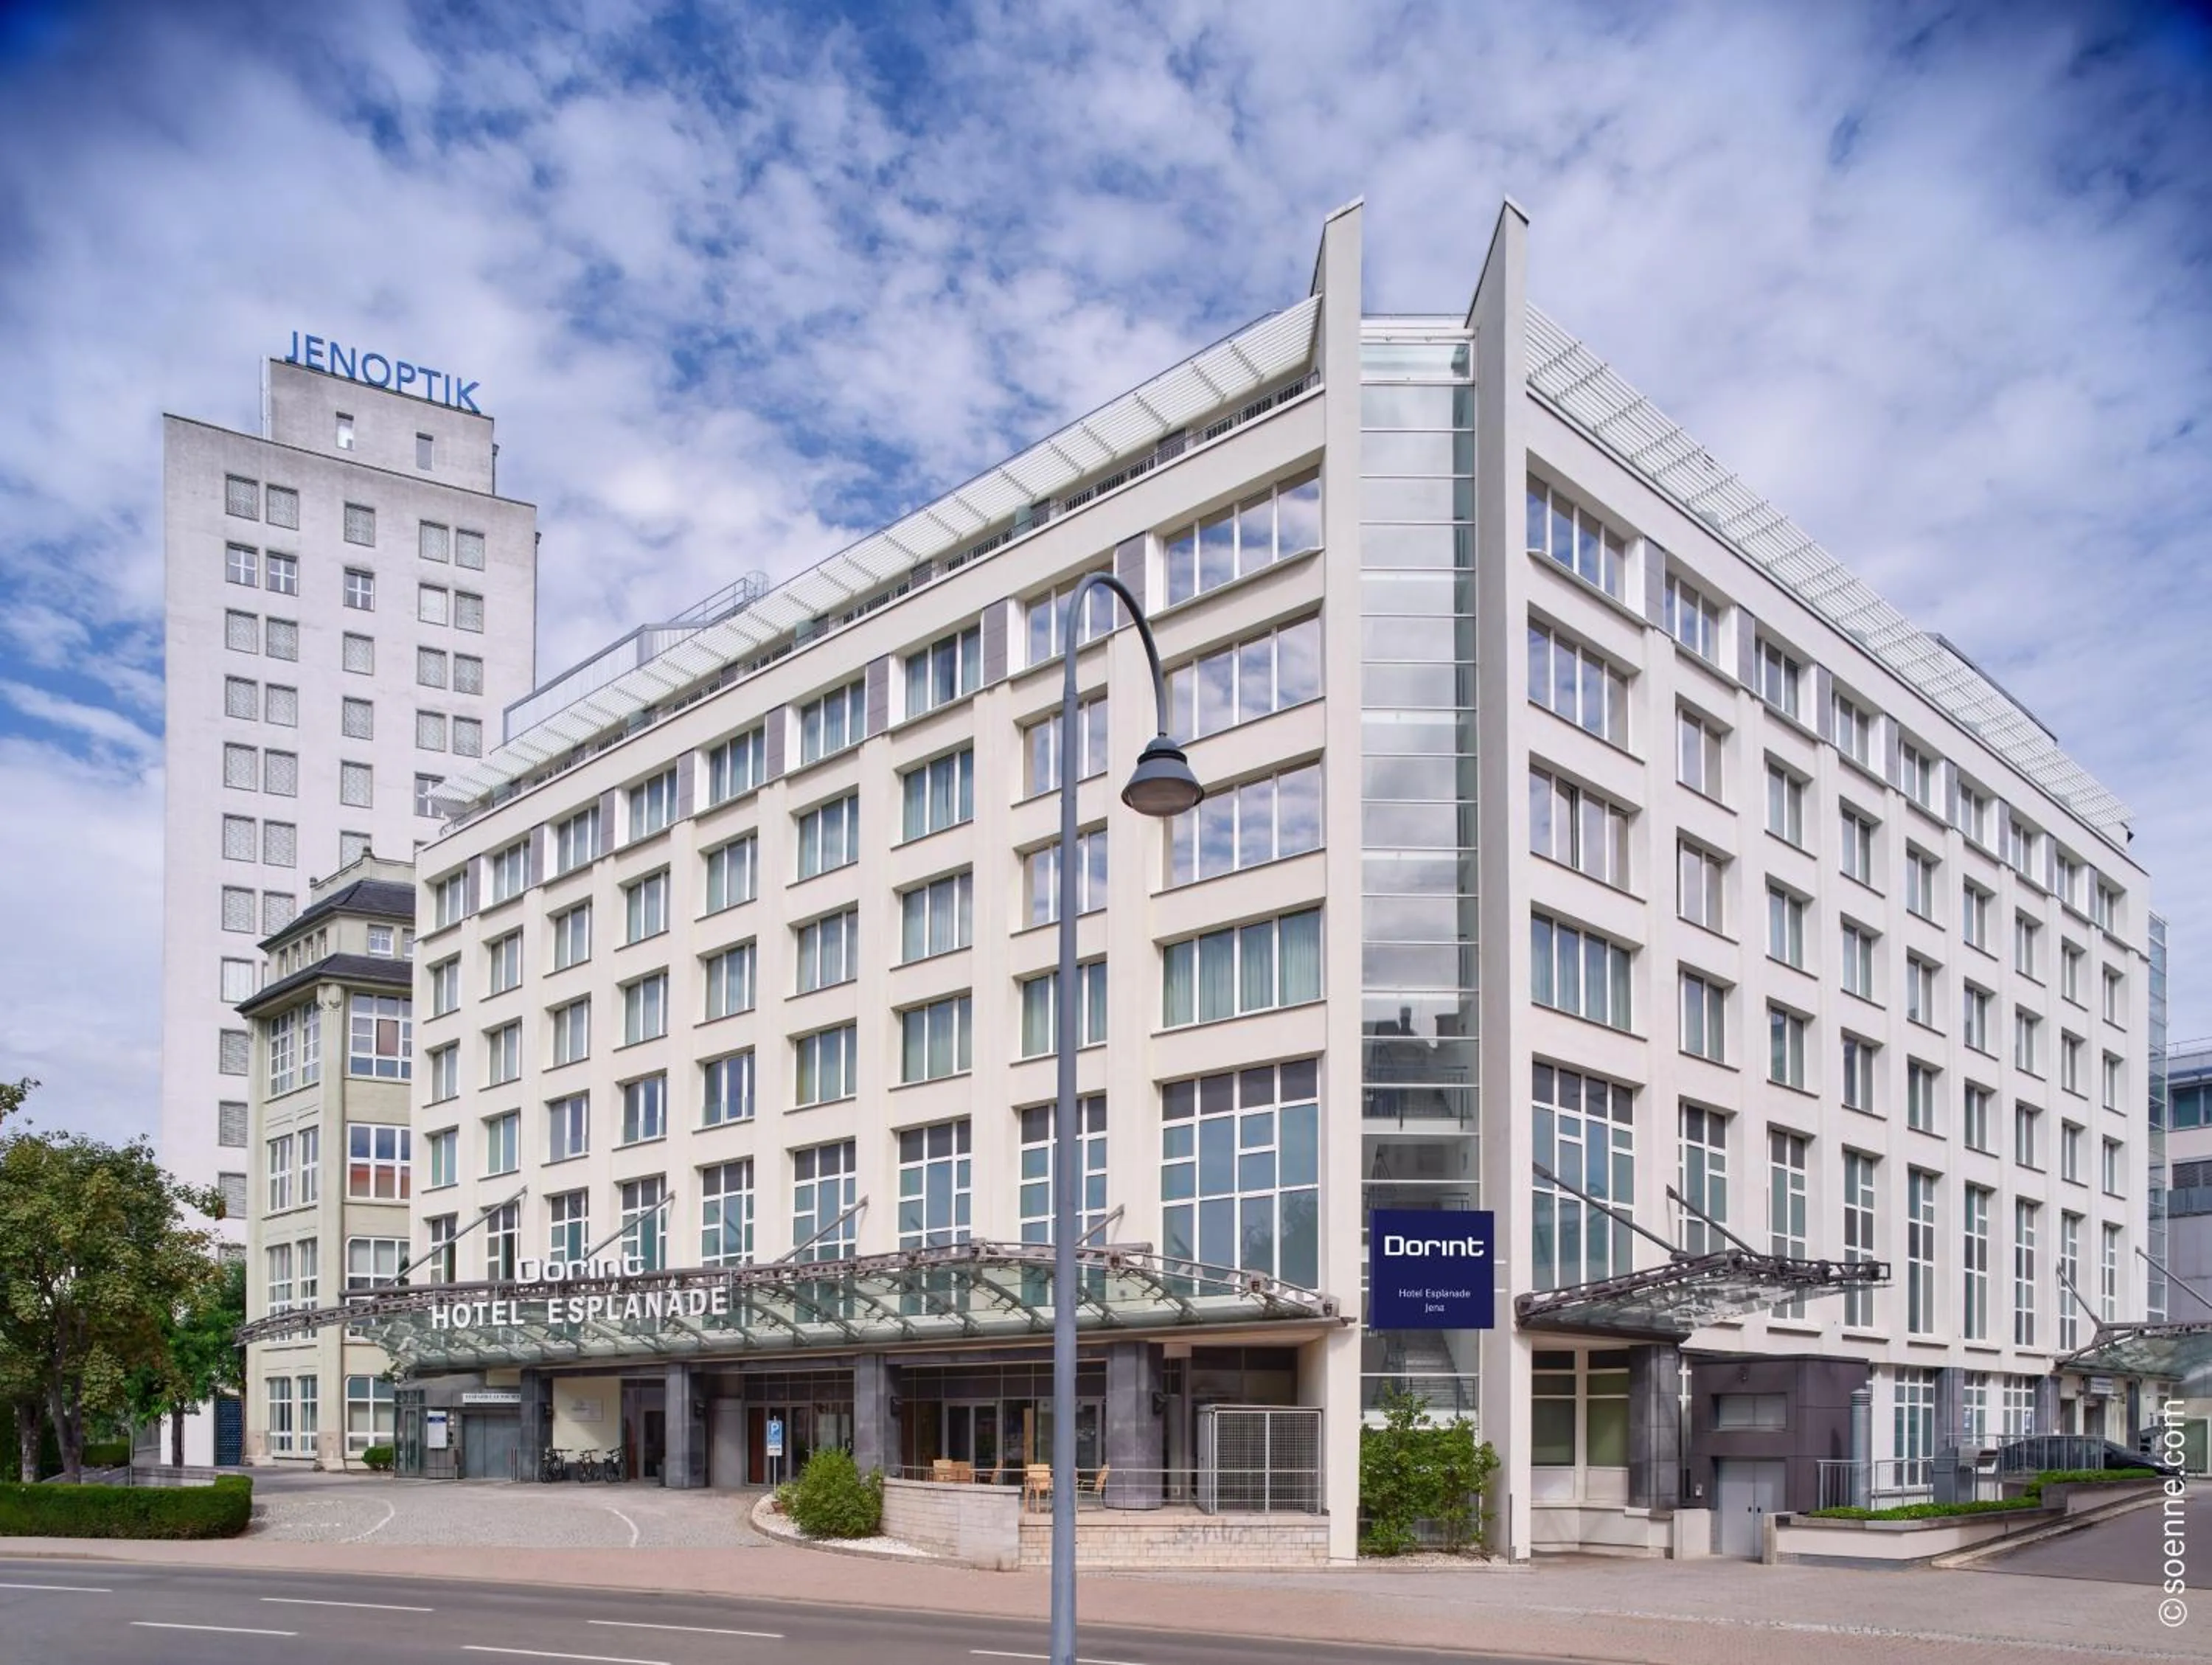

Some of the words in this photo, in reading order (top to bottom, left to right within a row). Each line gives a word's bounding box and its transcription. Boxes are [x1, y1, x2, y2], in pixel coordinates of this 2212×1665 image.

[285, 330, 481, 414] JENOPTIK
[1385, 1235, 1484, 1256] Dorint
[516, 1252, 646, 1284] Dorint
[1399, 1289, 1423, 1298] Hotel
[1425, 1289, 1471, 1299] Esplanade
[431, 1300, 525, 1329] HOTEL
[548, 1286, 728, 1324] ESPLANADE
[1425, 1303, 1444, 1313] Jena
